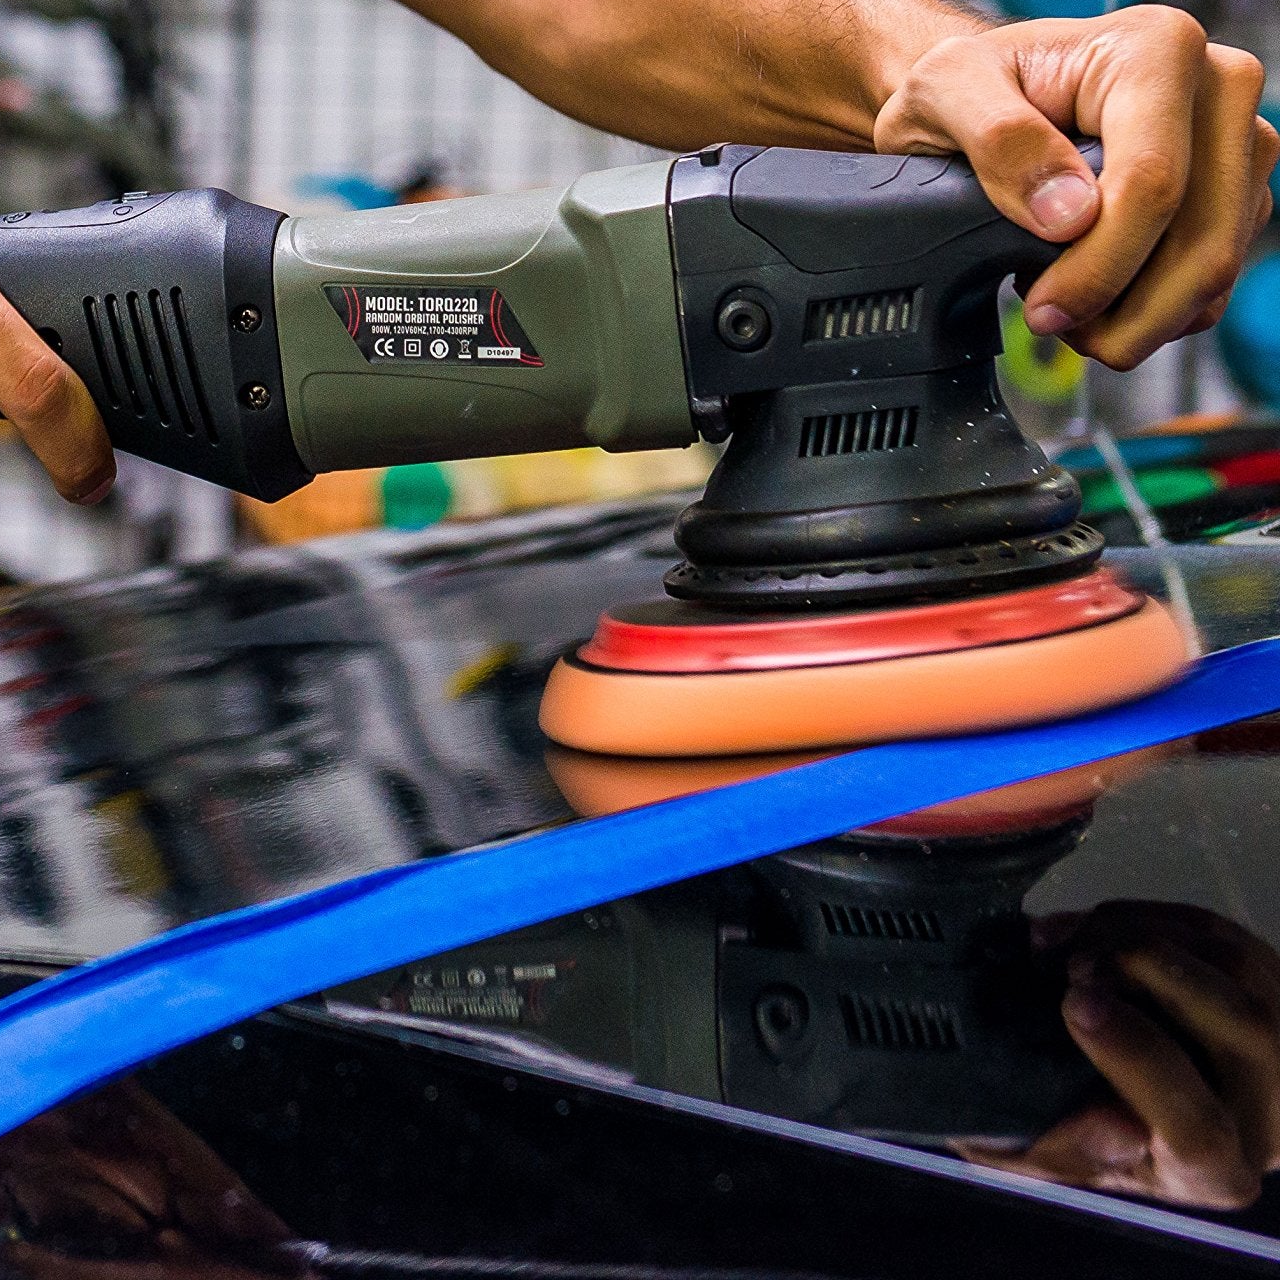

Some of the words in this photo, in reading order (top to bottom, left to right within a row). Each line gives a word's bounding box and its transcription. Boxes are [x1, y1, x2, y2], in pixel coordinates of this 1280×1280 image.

[365, 296, 414, 312] MODEL:
[417, 297, 478, 313] TORQ22D
[365, 312, 402, 324] RANDOM
[404, 313, 441, 324] ORBITAL
[442, 314, 484, 325] POLISHER
[371, 325, 392, 335] 900W,
